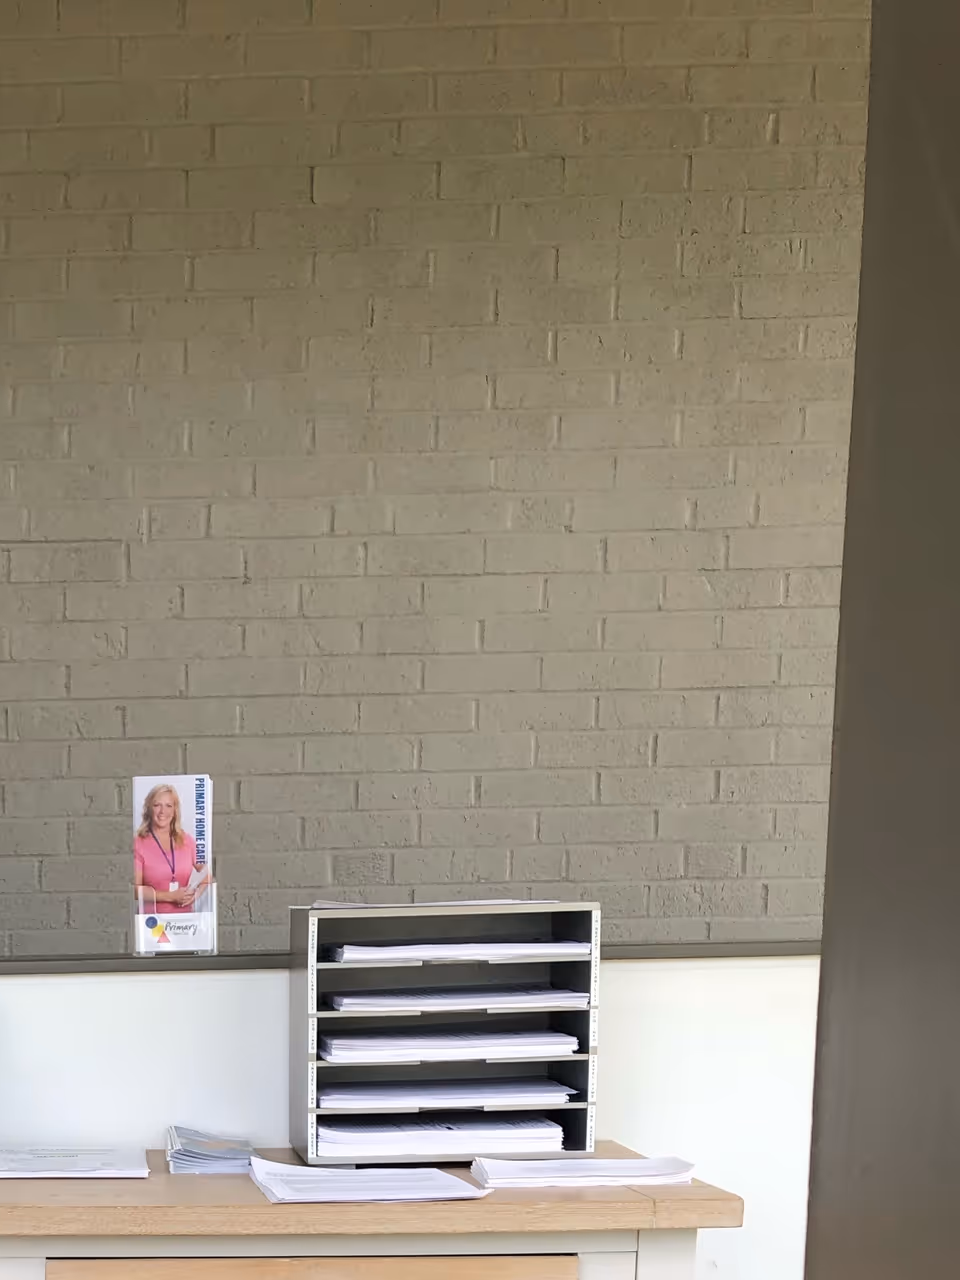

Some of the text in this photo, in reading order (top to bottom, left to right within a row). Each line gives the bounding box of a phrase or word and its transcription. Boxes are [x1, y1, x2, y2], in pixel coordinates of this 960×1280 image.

[194, 777, 206, 865] PRIMARY HOME CARE
[164, 922, 198, 936] Primary
